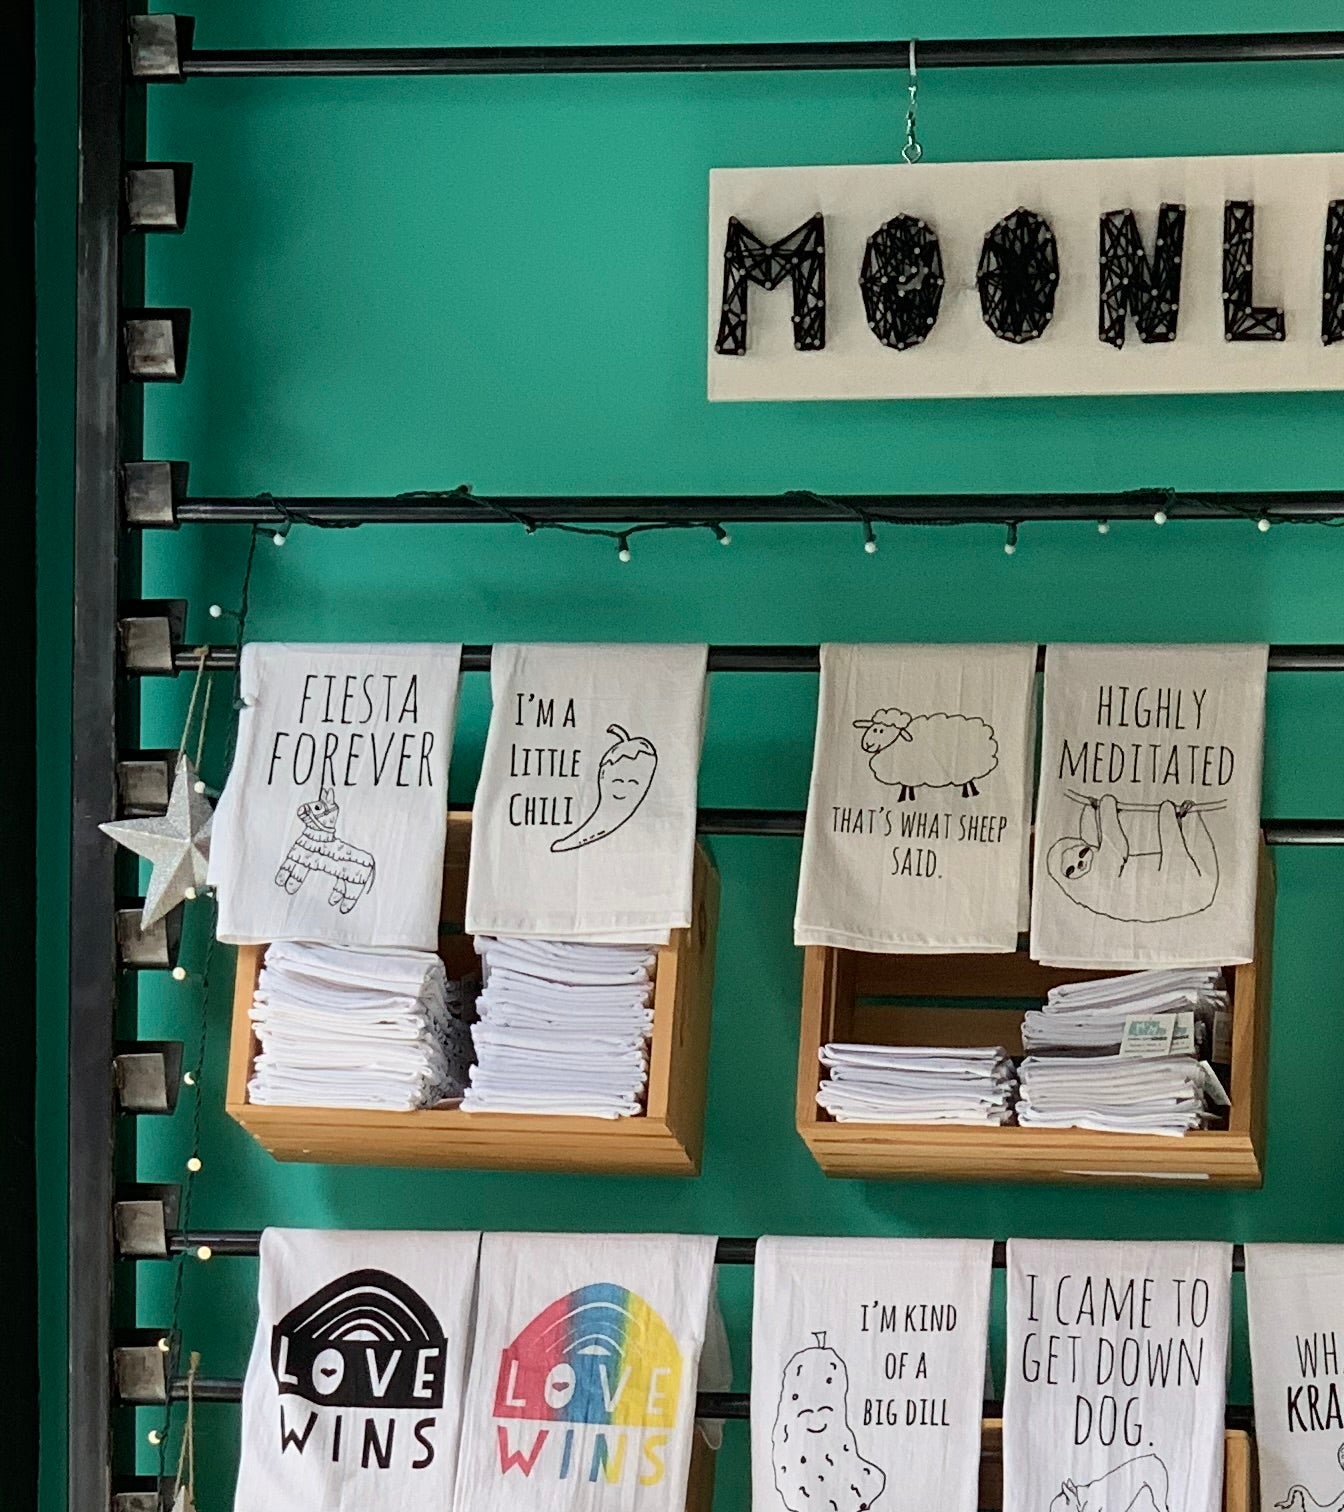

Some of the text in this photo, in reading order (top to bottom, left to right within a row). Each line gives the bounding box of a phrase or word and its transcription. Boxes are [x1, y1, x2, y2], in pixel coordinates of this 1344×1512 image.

[298, 674, 419, 725] FIESTA
[515, 693, 576, 728] I'M A
[1097, 686, 1206, 731] HIGHLY
[267, 731, 435, 788] FOREVER
[510, 743, 581, 778] LITTLE
[1058, 739, 1234, 788] MEDITATED
[509, 793, 573, 826] CHILI
[832, 806, 1008, 843] THAT'S WHAT SHEEP
[891, 846, 943, 879] SAID.
[860, 1301, 957, 1333] I'M KIND
[1026, 1274, 1209, 1329] I CAME TO
[277, 1334, 441, 1398] LOVE
[885, 1352, 928, 1380] OF A
[1022, 1332, 1205, 1387] GET DOWN
[505, 1358, 671, 1417] LOVE
[863, 1398, 951, 1427] BIG DILL
[1074, 1395, 1155, 1447] DOG.
[279, 1411, 437, 1470] WINS
[496, 1425, 669, 1487] WINS
